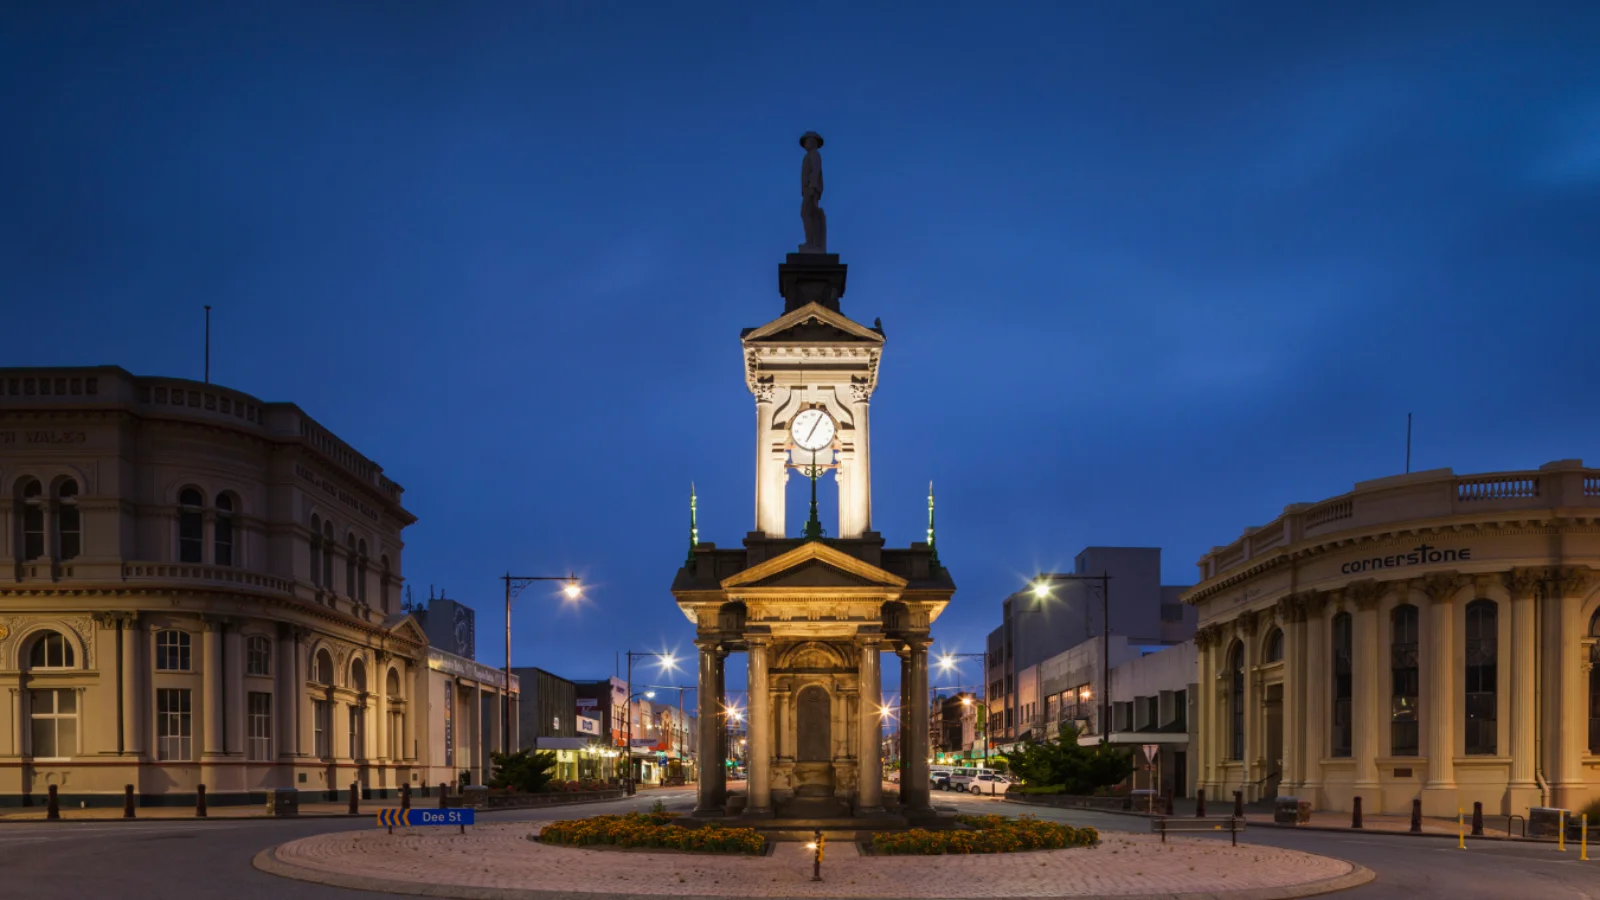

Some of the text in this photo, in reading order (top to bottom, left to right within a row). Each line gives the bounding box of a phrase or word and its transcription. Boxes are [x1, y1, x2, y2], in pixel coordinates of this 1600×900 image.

[1342, 544, 1471, 574] cornerstone
[423, 812, 462, 822] Dee St
